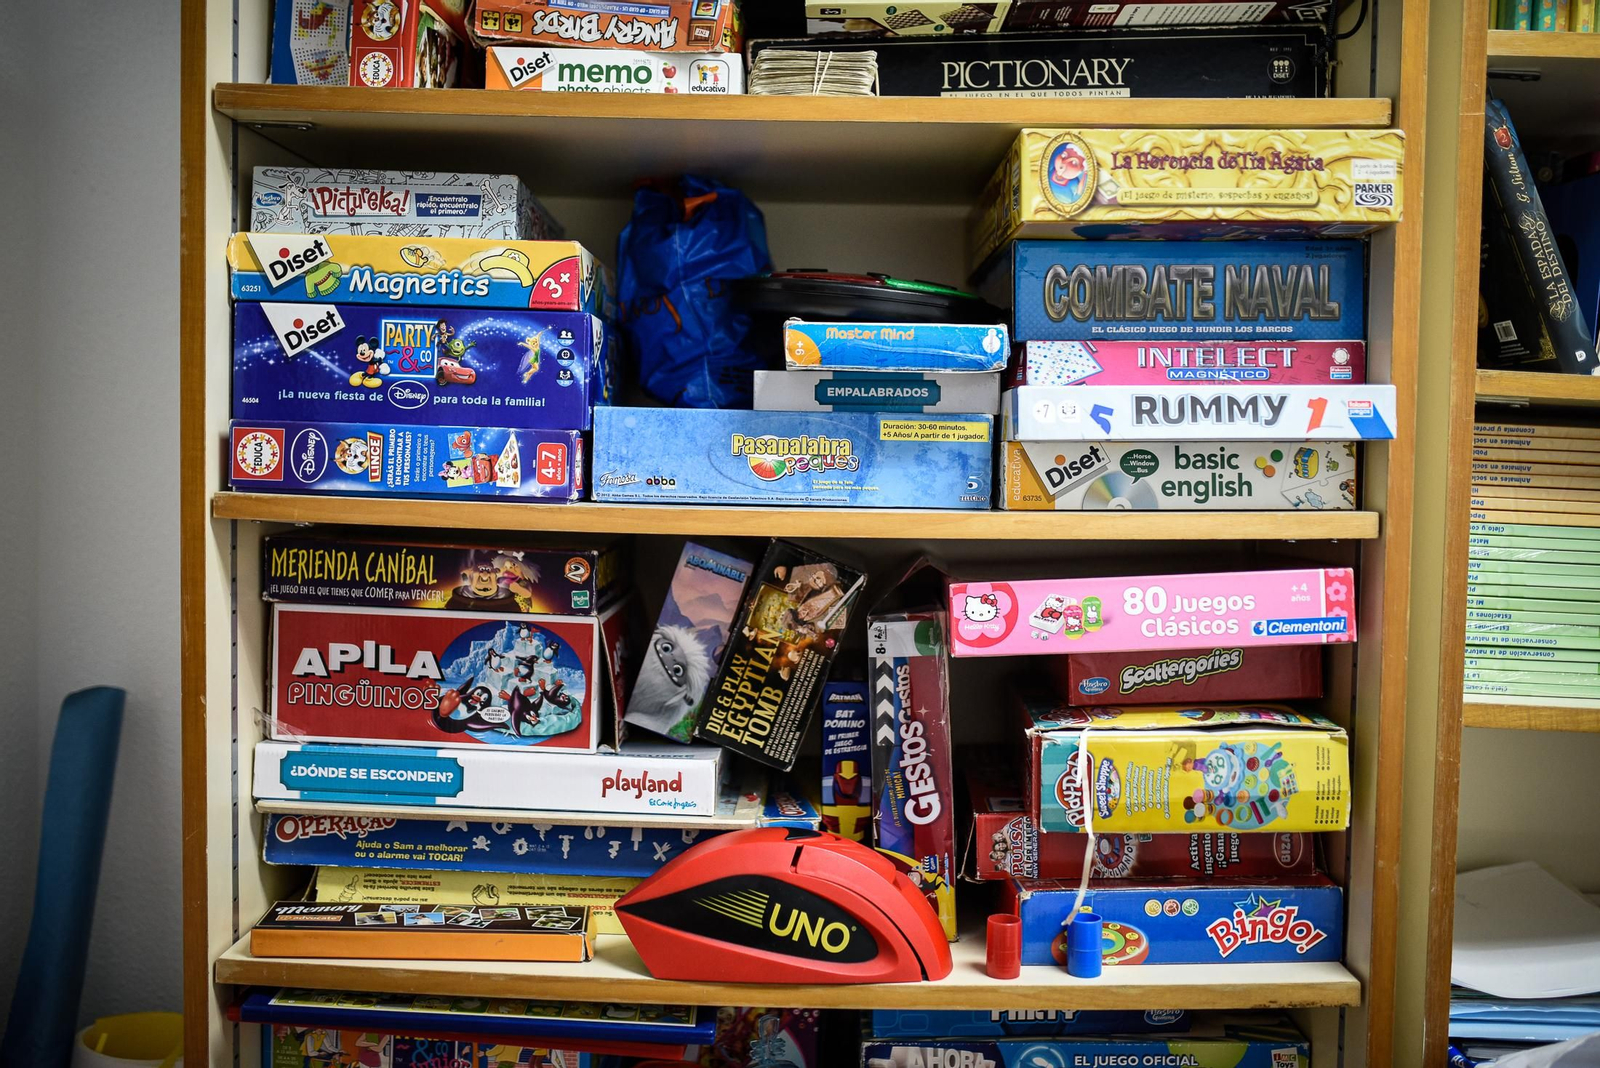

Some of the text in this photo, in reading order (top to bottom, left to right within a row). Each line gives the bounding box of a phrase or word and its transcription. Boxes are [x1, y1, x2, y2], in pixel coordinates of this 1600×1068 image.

[532, 11, 678, 49] ANGRY BIRDS
[372, 57, 380, 87] EDUCA
[510, 51, 551, 82] Diset
[558, 63, 653, 84] memo
[941, 58, 1131, 89] PICTIONARY
[691, 83, 727, 94] educativa
[308, 186, 409, 216] ¡Pictureka!
[427, 195, 468, 203] ¡Encuéntralo
[1136, 193, 1160, 201] juego
[1219, 191, 1262, 200] sospechas
[1355, 184, 1393, 193] PARKER
[439, 202, 478, 210] encuéntralo
[268, 239, 328, 281] Diset
[1530, 230, 1560, 299] LA ESPADA
[1537, 220, 1573, 305] DEL DESTINO
[241, 284, 262, 293] 63251
[350, 270, 489, 298] Magnetics
[1045, 264, 1341, 321] COMBATE NAVAL
[284, 310, 339, 350] Diset
[386, 323, 434, 348] PARTY
[826, 328, 914, 341] Master Mind
[1107, 324, 1146, 333] CLÁSICO
[1196, 325, 1231, 333] HUNDIR
[1235, 325, 1253, 333] LOS
[1256, 325, 1292, 333] BARCOS
[398, 346, 432, 373] & CO
[795, 340, 805, 356] 9+
[1138, 347, 1297, 368] INTELECT
[279, 386, 546, 407] ¡La nueva fiesta de Disney para toda la familia!
[827, 386, 929, 398] EMPALABRADOS
[1090, 404, 1114, 434] 5
[1134, 394, 1290, 426] RUMMY
[1306, 397, 1328, 433] 1
[883, 423, 916, 431] Duración:
[923, 433, 940, 441] partir
[957, 433, 985, 441] jugador.
[253, 441, 263, 468] EDUCA
[299, 432, 320, 476] Disney
[403, 431, 412, 486] TUS PERSONAJES?
[733, 434, 852, 457] Pasapalabra
[1175, 446, 1239, 471] basic
[542, 450, 557, 479] 4-7
[785, 454, 860, 476] Peques
[1010, 448, 1021, 501] educativa
[1045, 446, 1105, 488] Diset
[646, 475, 676, 486] abba
[1161, 473, 1252, 504] english
[272, 548, 437, 585] MERIENDA CANÍBAL
[687, 555, 746, 583] ABOMINABLE
[270, 584, 444, 602] ¡EL JUEGO EN EL QUE TIENES QUE COMER PARA VENCER!
[1122, 586, 1256, 616] 80 Juegos
[1140, 616, 1240, 638] Clásicos
[1268, 618, 1345, 635] Clementoni
[876, 643, 886, 655] 8+
[1510, 650, 1555, 658] Conservación
[1512, 637, 1557, 645] Conservación
[291, 640, 437, 679] APILA
[1121, 650, 1242, 691] Scattergories
[288, 679, 440, 710] PINGÜINOS
[706, 653, 748, 734] DIG & PLAY
[720, 627, 785, 742] EGYPTIAN
[828, 693, 863, 702] BATMAN
[741, 685, 785, 749] TOMB
[824, 720, 866, 728] DOMINO
[835, 710, 855, 718] BAT
[290, 763, 454, 783] ¿DÓNDE SE ESCONDEN?
[602, 769, 682, 799] playland
[1095, 759, 1110, 817] Sweet Shoppe
[356, 840, 382, 851] Ajuda
[393, 842, 414, 850] Sam
[425, 843, 468, 852] melhorar
[377, 851, 410, 860] alarme
[428, 852, 463, 862] TOCAR!
[1011, 818, 1023, 875] PULSA
[1190, 833, 1200, 870] Activa
[1203, 833, 1214, 874] ingenio
[1229, 832, 1240, 863] juego
[275, 905, 362, 914] Memory
[769, 903, 850, 953] UNO
[1206, 906, 1327, 958] Bingo!
[1074, 1056, 1198, 1067] EL JUEGO OFICIAL
